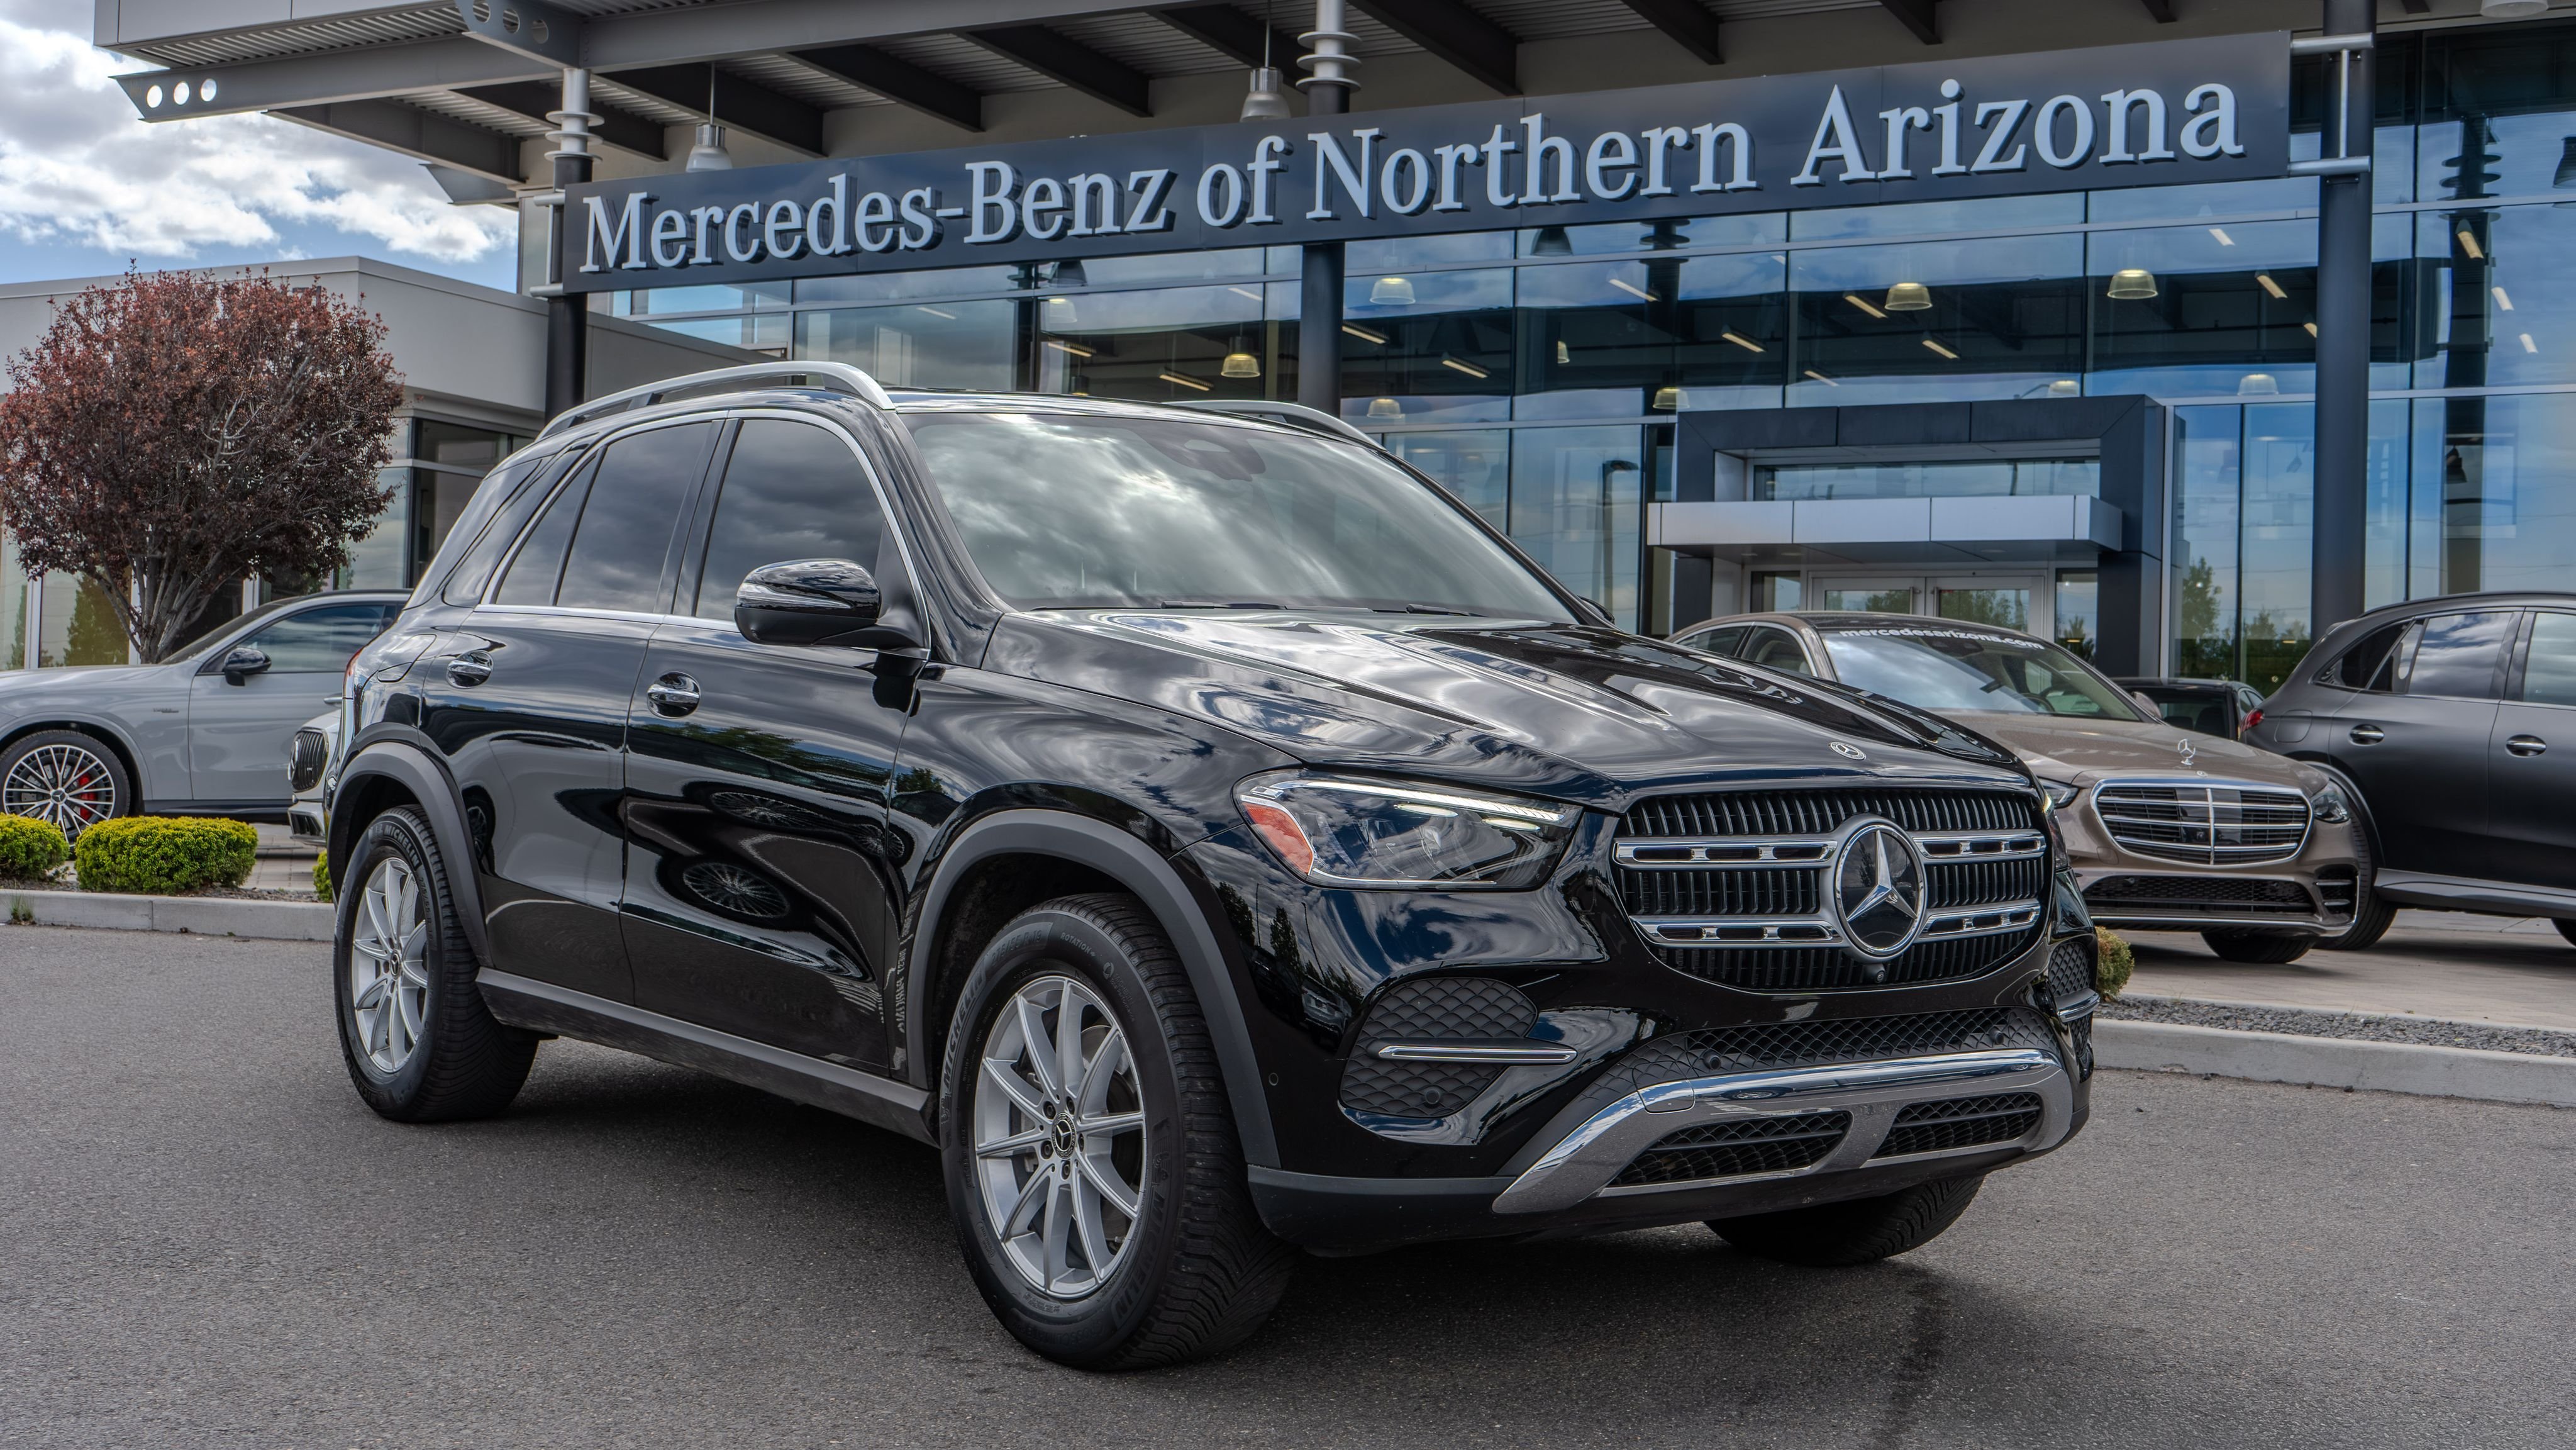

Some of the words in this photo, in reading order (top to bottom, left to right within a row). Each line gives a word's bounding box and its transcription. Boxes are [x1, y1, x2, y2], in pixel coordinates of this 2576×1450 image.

[579, 160, 1176, 273] Mercedes-Benz
[1196, 135, 1294, 228] of
[1306, 112, 1763, 222] Northern
[1790, 79, 2247, 186] Arizona
[1839, 628, 2045, 650] mercedesarizona.com
[384, 825, 421, 869] MICHELIN
[1060, 931, 1092, 956] ROTATION
[943, 968, 985, 1093] MICHELIN
[1116, 1192, 1166, 1323] MICHELIN
